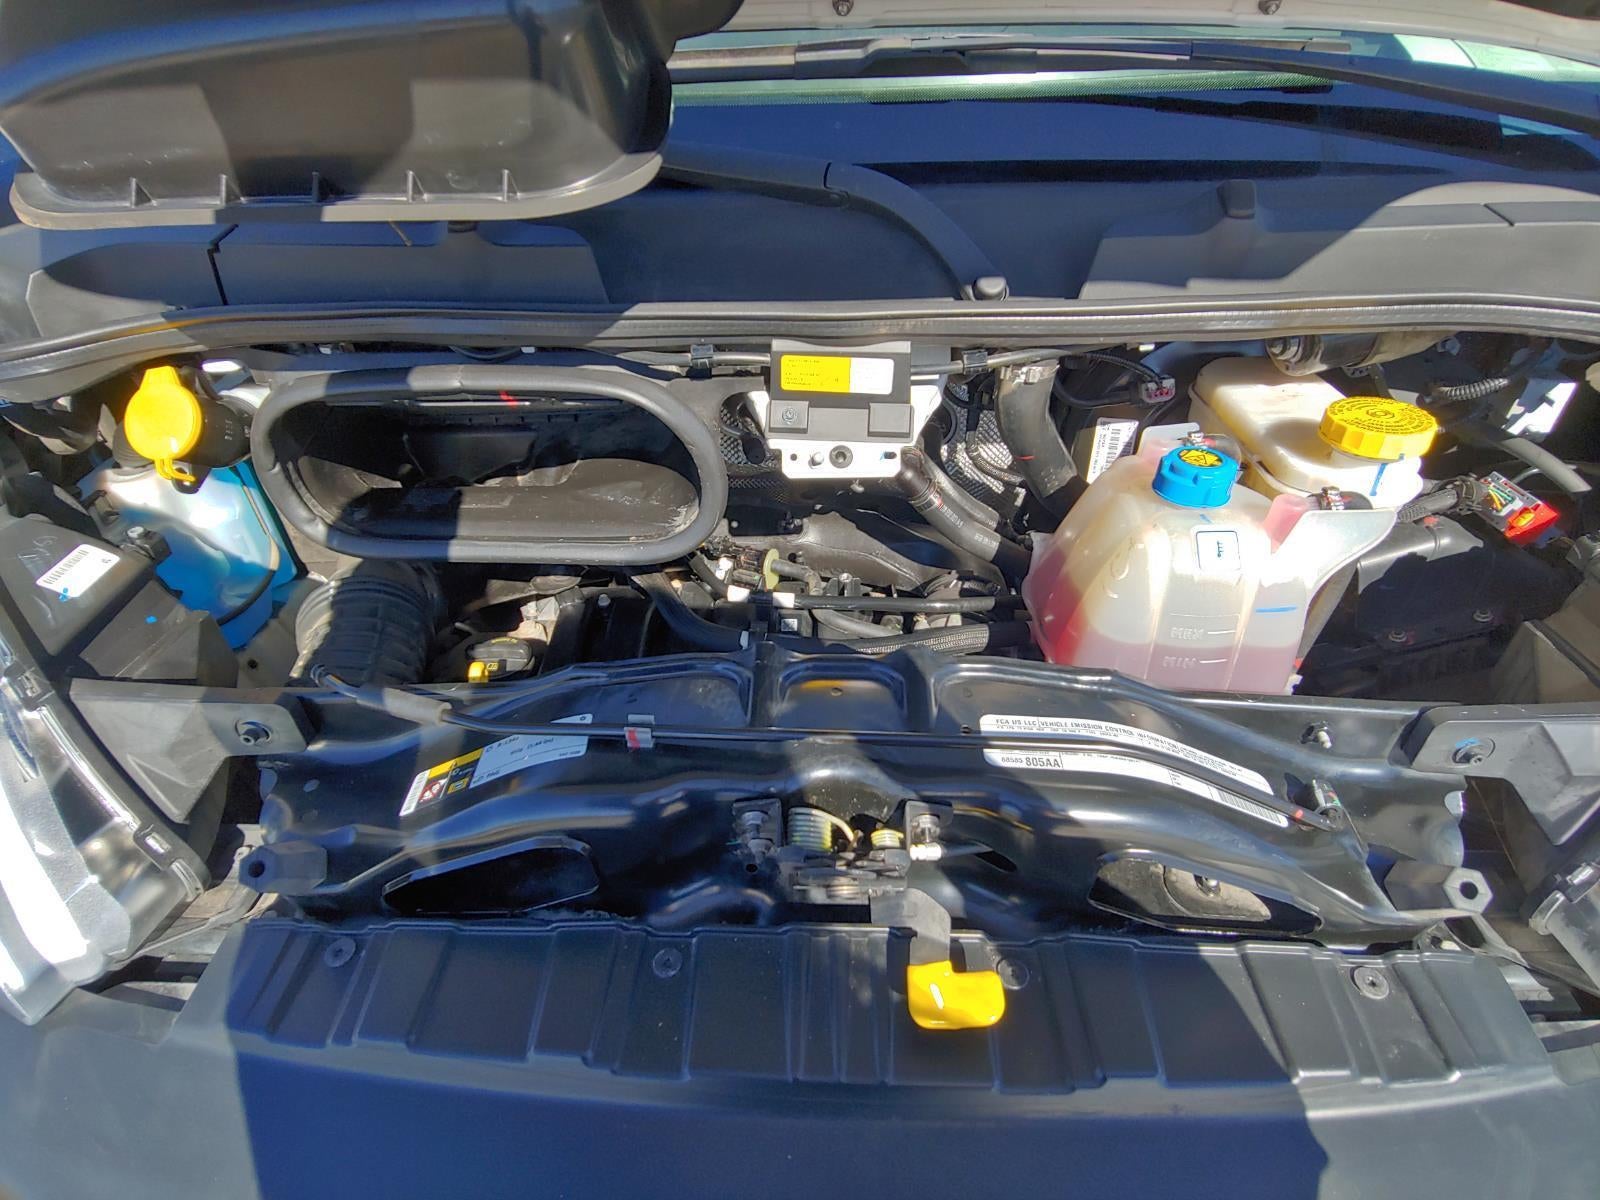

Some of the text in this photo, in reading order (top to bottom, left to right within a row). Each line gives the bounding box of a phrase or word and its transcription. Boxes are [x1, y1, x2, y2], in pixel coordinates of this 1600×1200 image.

[1070, 722, 1103, 731] EMISSION
[1104, 725, 1136, 737] CONTROL
[1025, 756, 1061, 769] 805AA
